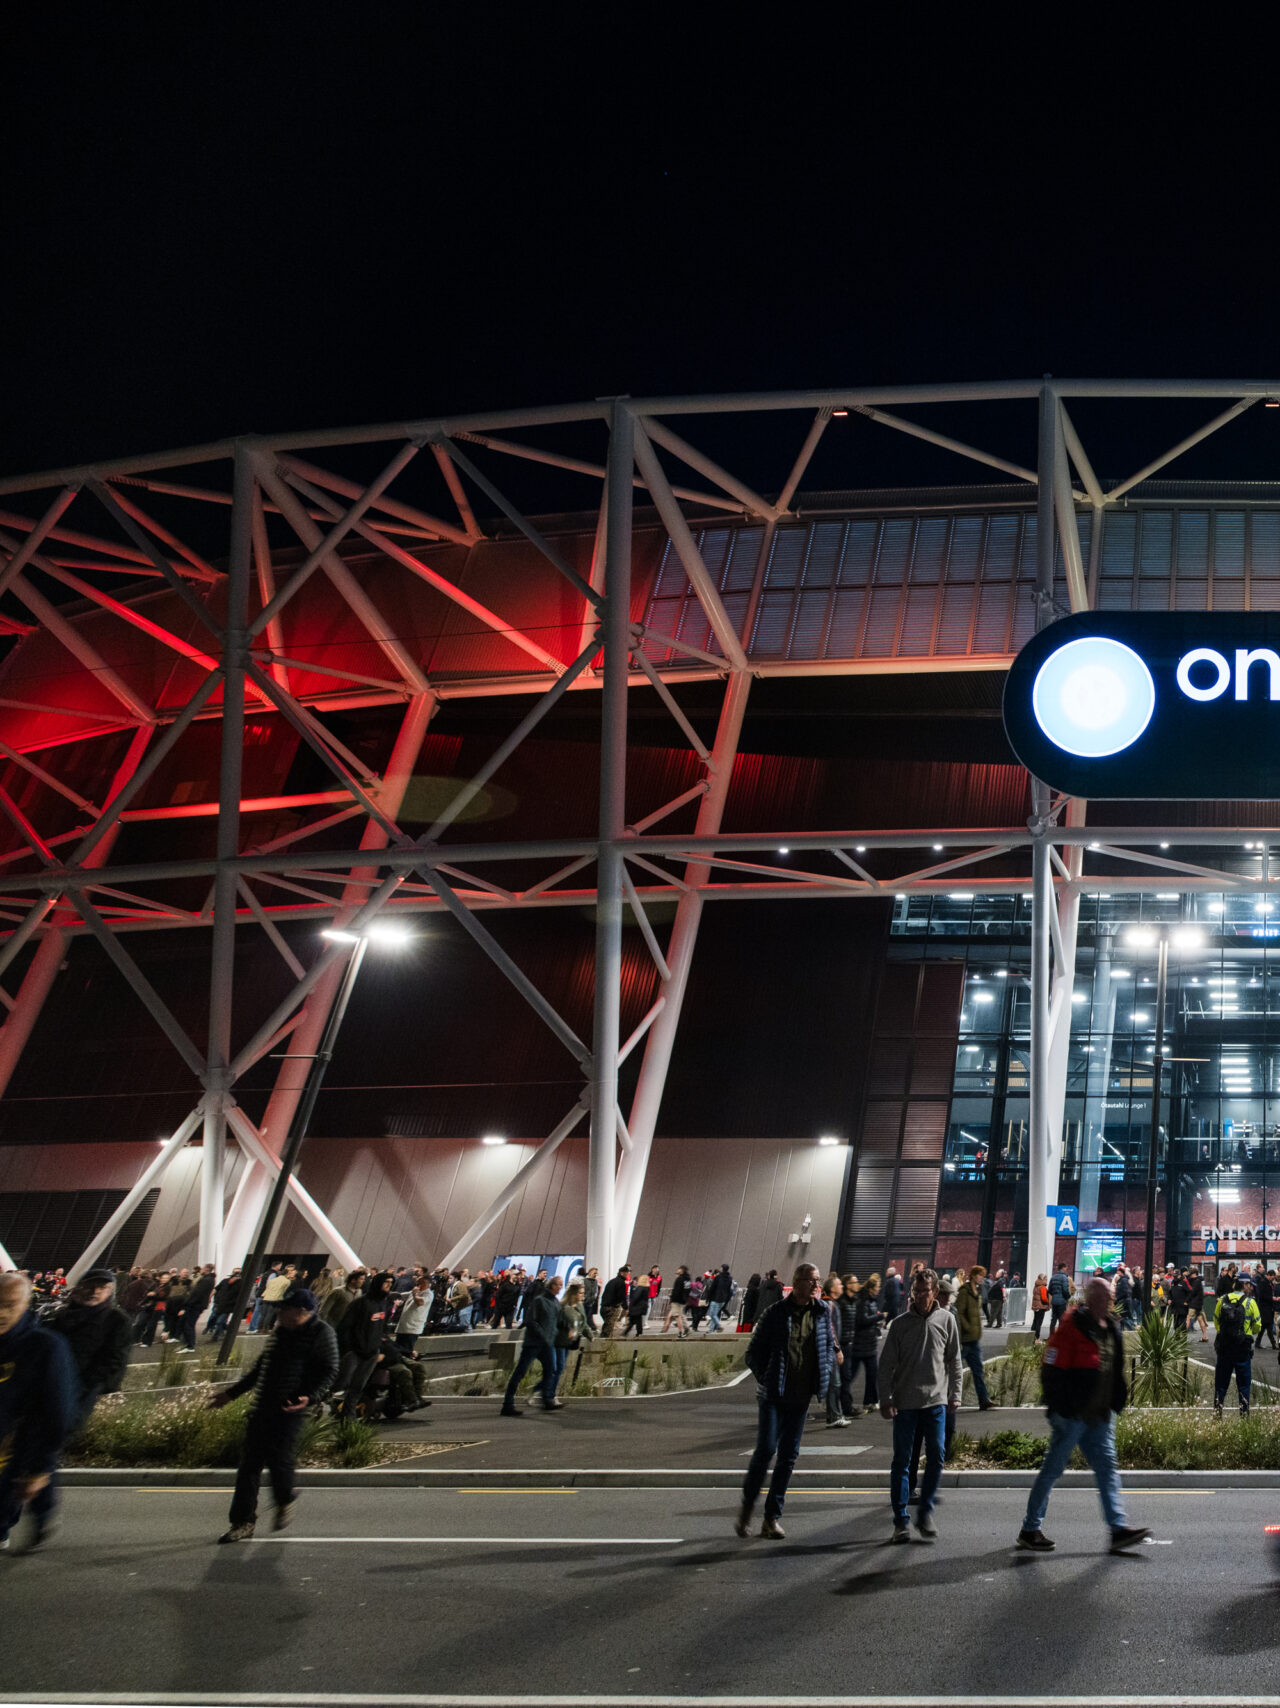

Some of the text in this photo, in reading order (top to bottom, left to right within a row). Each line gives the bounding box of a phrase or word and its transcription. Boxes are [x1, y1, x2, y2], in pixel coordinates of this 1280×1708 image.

[1059, 1216, 1074, 1231] A
[1200, 1226, 1261, 1240] ENTRY
[1207, 1243, 1215, 1252] A
